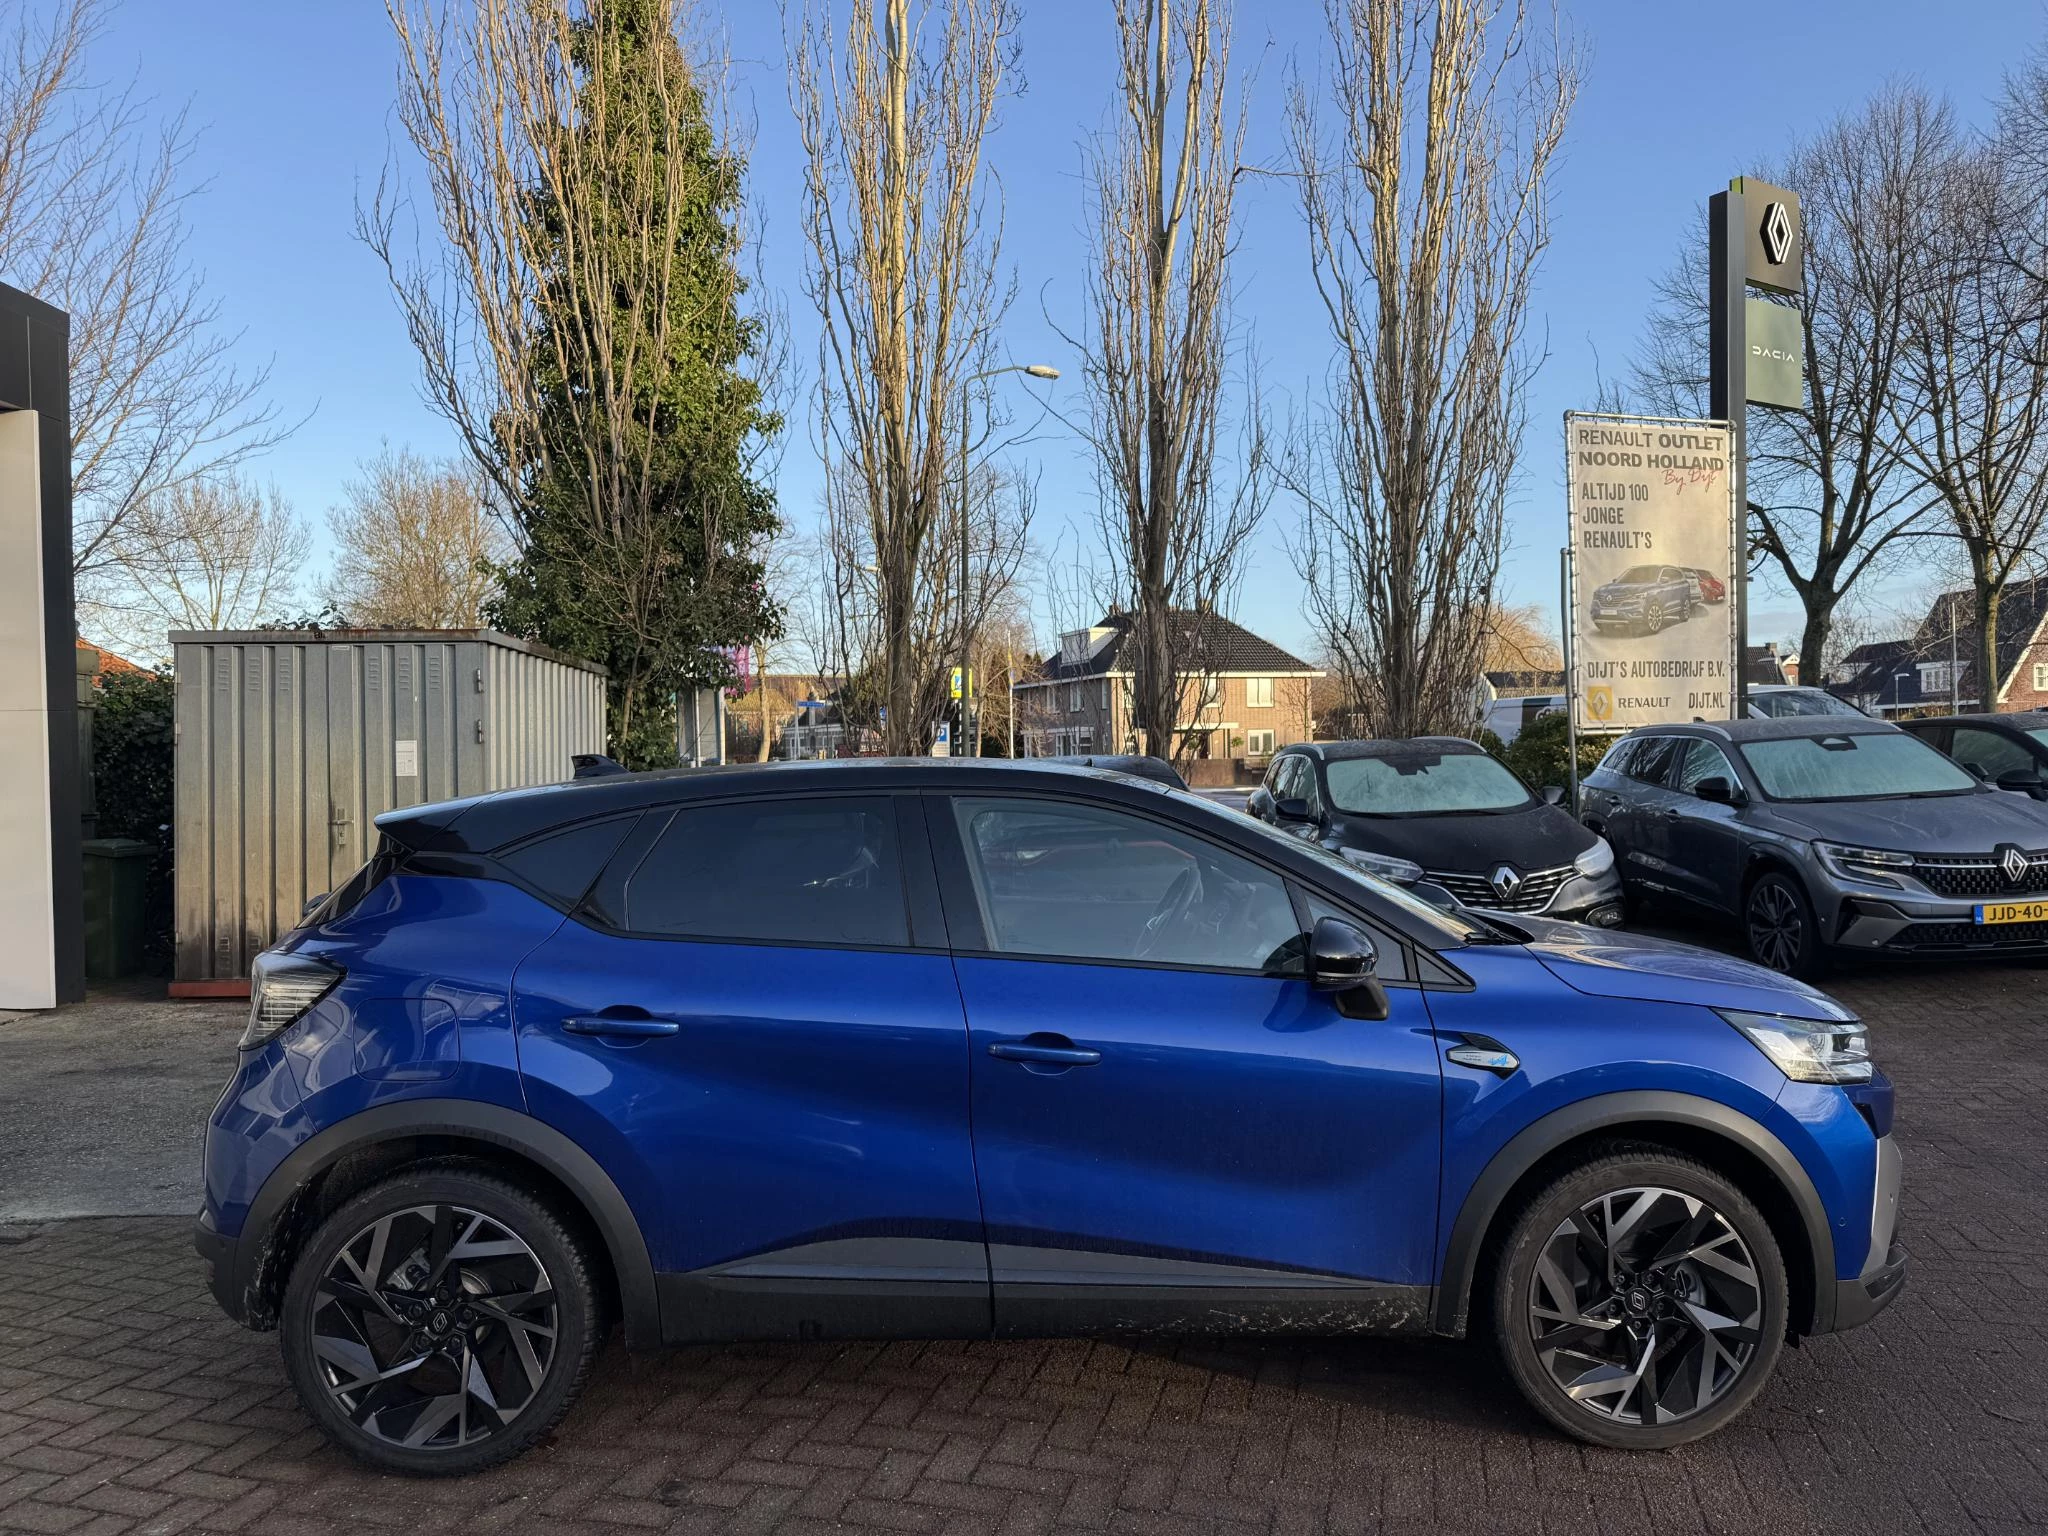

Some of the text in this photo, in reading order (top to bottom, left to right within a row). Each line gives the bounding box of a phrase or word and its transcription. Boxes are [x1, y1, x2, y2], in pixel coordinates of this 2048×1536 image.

[1752, 345, 1795, 362] DACIA
[1579, 430, 1723, 451] RENAULT OUTLET
[1579, 452, 1724, 471] NOORD HOLLAND
[1662, 469, 1686, 495] By
[1582, 482, 1649, 501] ALTIJD 100
[1583, 507, 1624, 525] JONGE
[1584, 531, 1652, 549] RENAULT'S
[1588, 661, 1725, 678] DIJT'S AUTOBEDRIJF B.V.
[1618, 692, 1725, 709] RENAULT DIJT.NL
